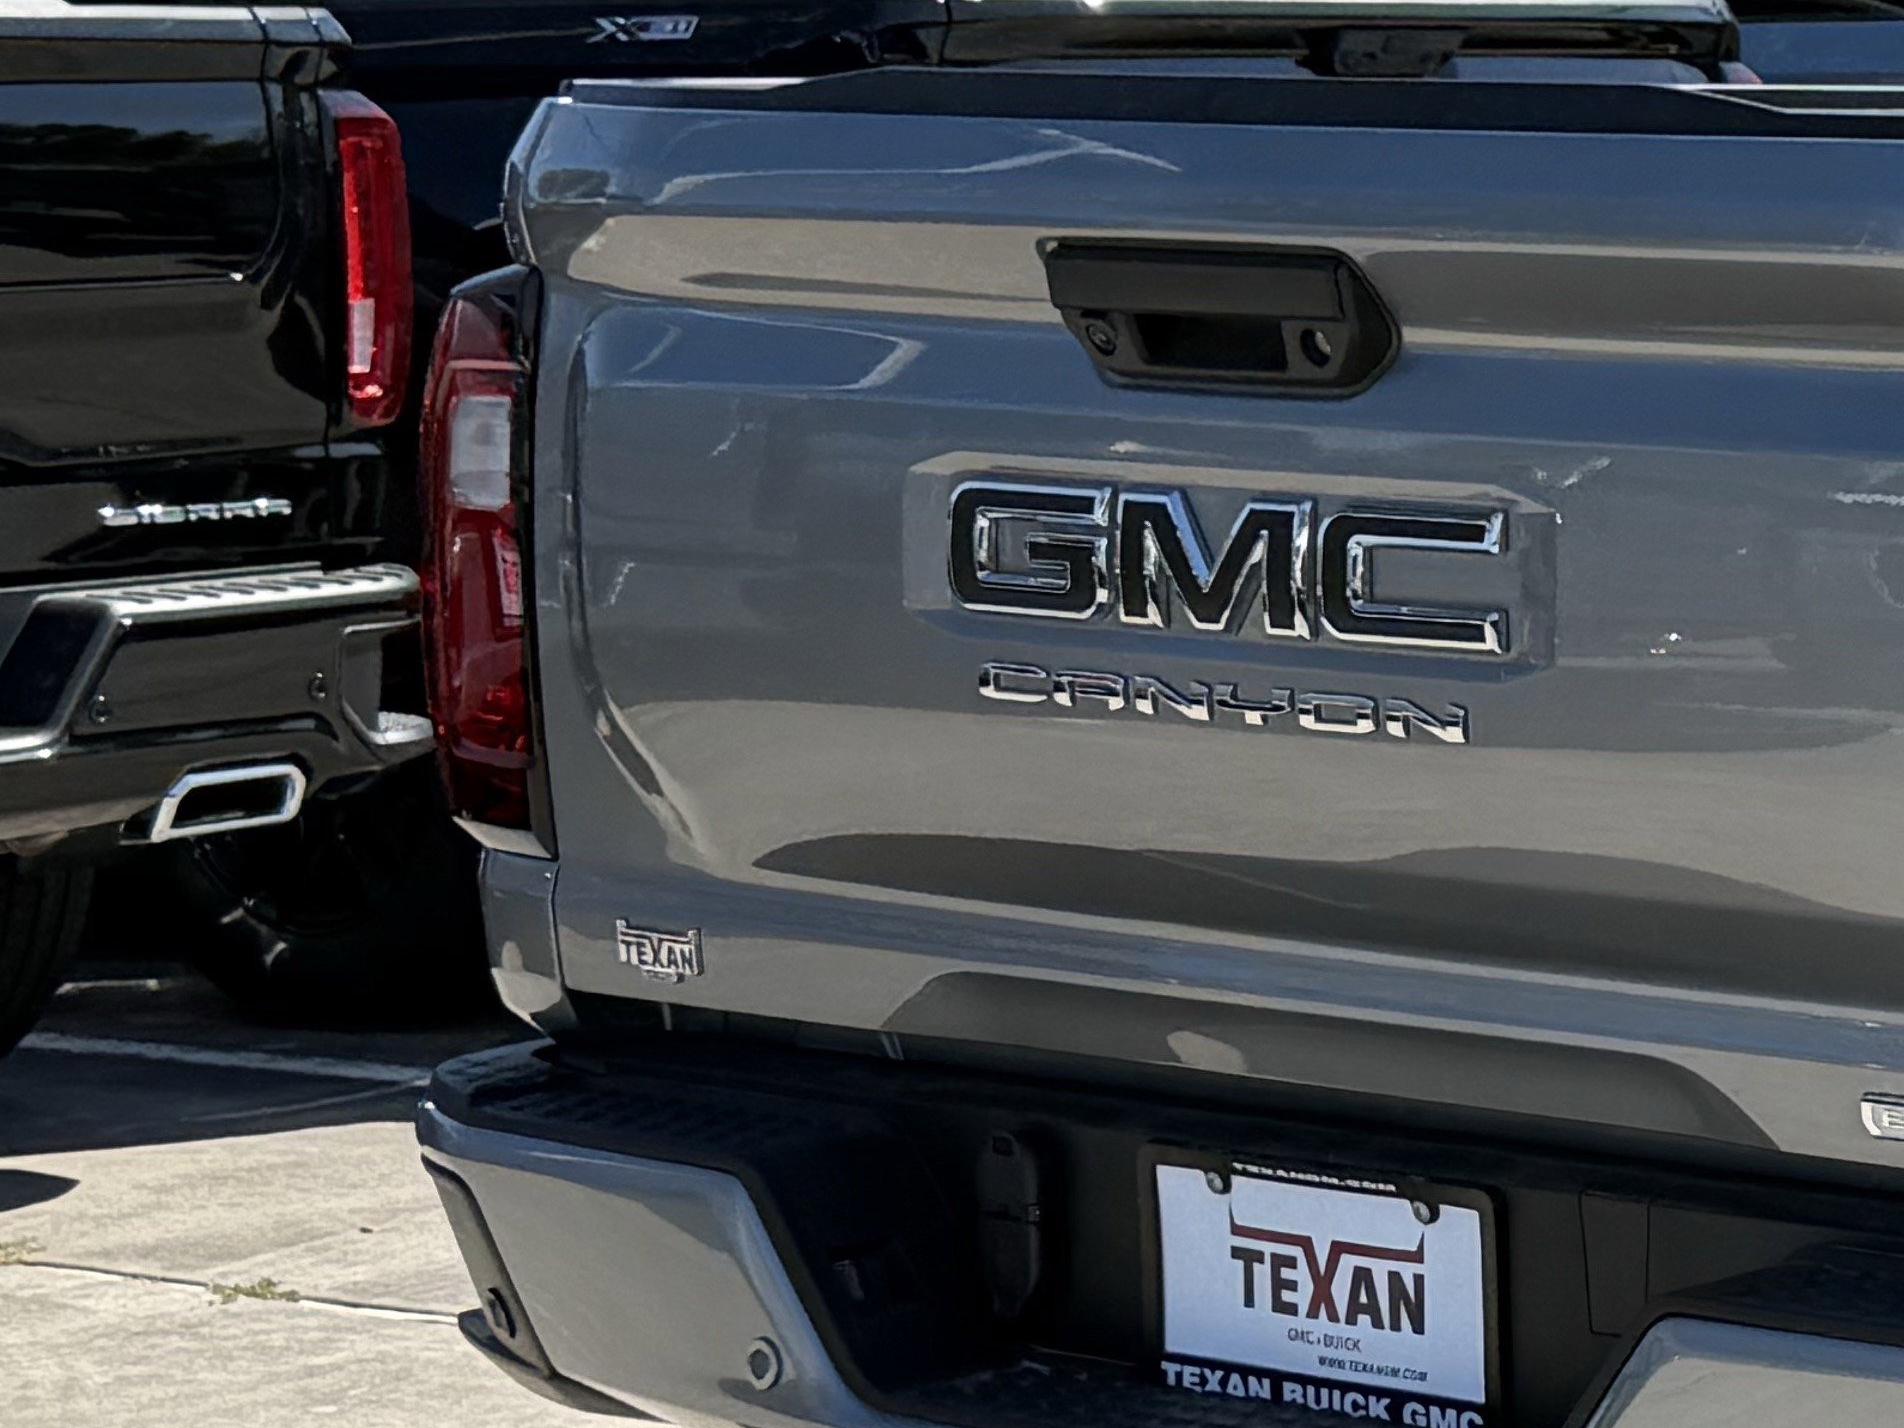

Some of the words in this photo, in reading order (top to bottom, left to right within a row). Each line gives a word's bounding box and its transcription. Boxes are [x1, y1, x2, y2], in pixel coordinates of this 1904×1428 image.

[949, 480, 1507, 654] GMC
[978, 660, 1471, 745] CANYON
[618, 929, 697, 975] TEXAN
[1229, 1227, 1426, 1336] TEXAN
[1161, 1360, 1271, 1401] TEXAN
[1281, 1380, 1391, 1421] BUICK
